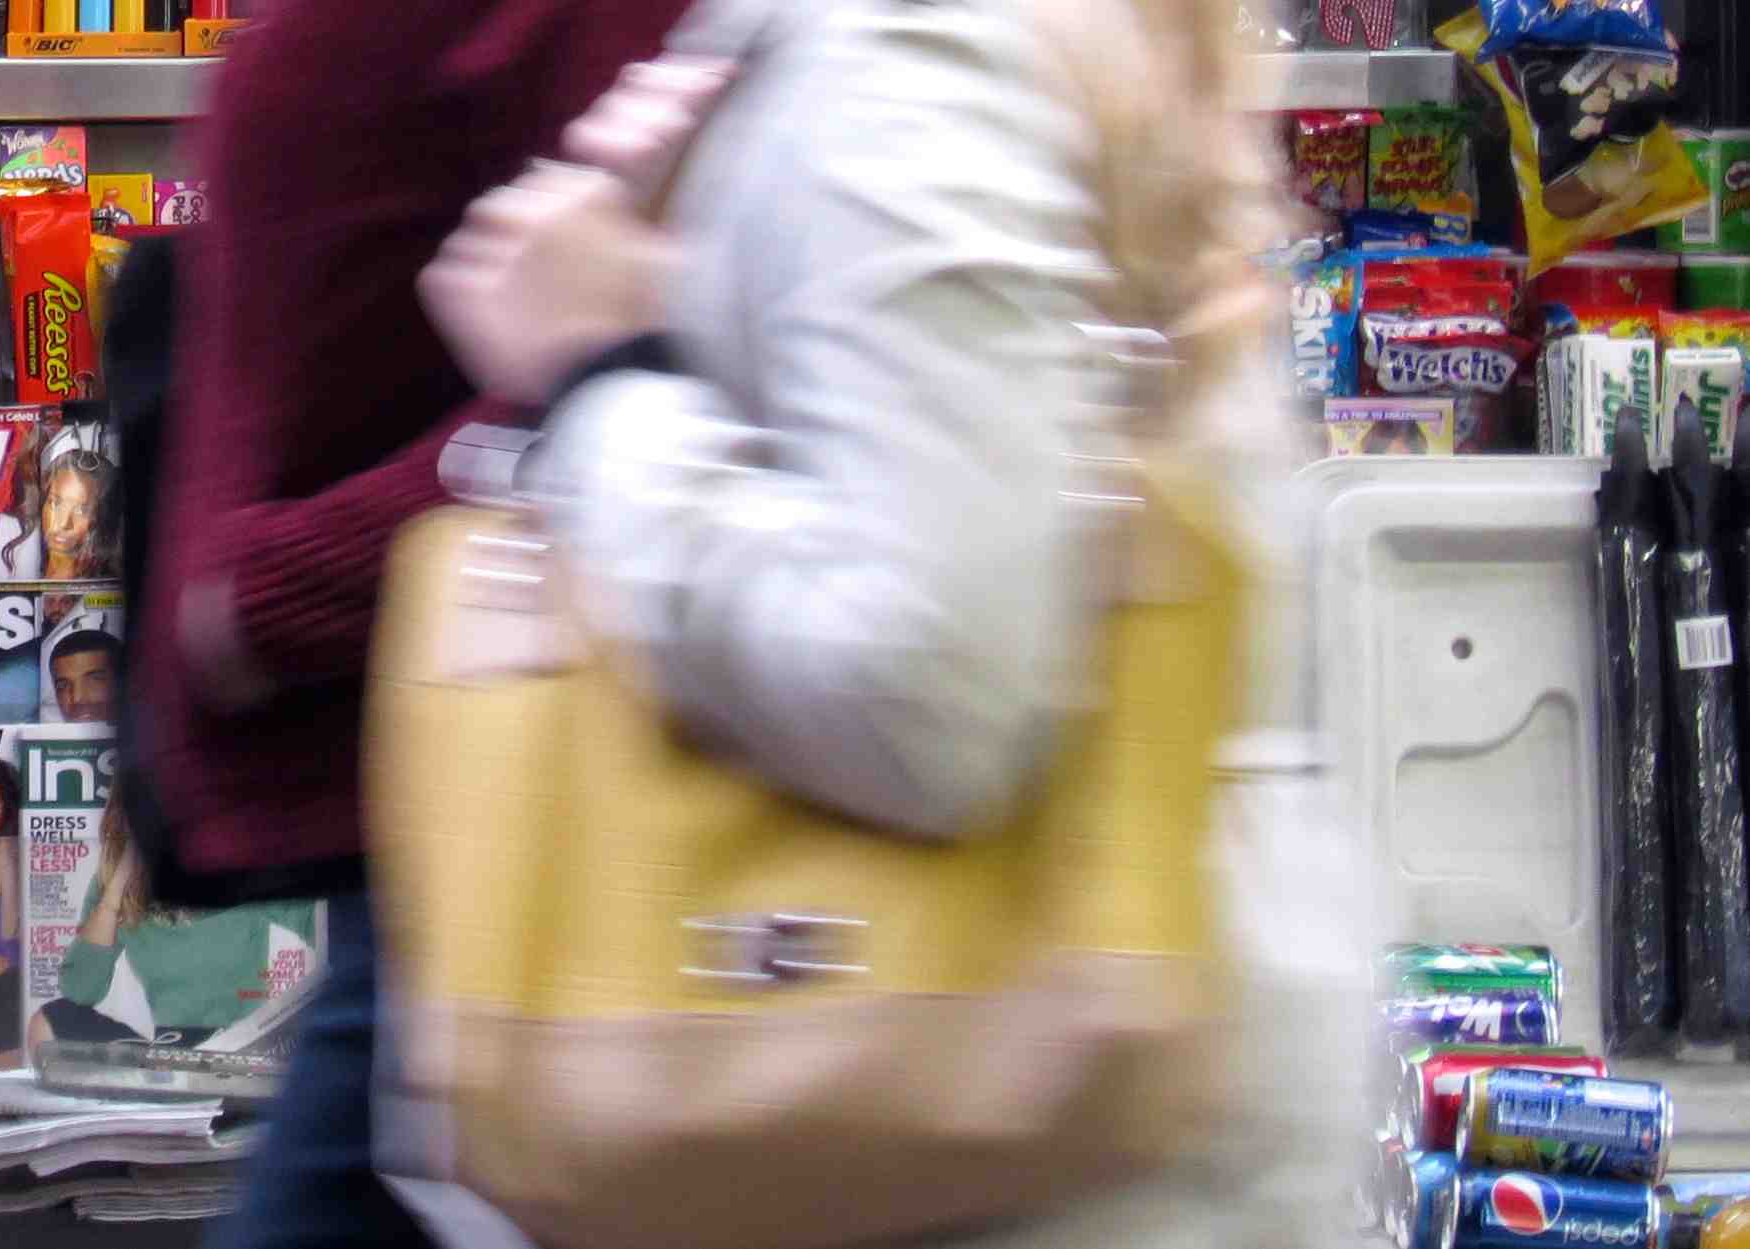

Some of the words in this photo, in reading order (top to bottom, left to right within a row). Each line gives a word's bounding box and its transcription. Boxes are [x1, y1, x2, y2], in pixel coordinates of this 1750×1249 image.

[34, 39, 76, 52] BIC
[1389, 352, 1509, 386] Welch's
[30, 816, 87, 830] DRESS
[30, 831, 84, 845] WELL,
[30, 846, 90, 859] SPEND
[30, 859, 77, 873] LESS!
